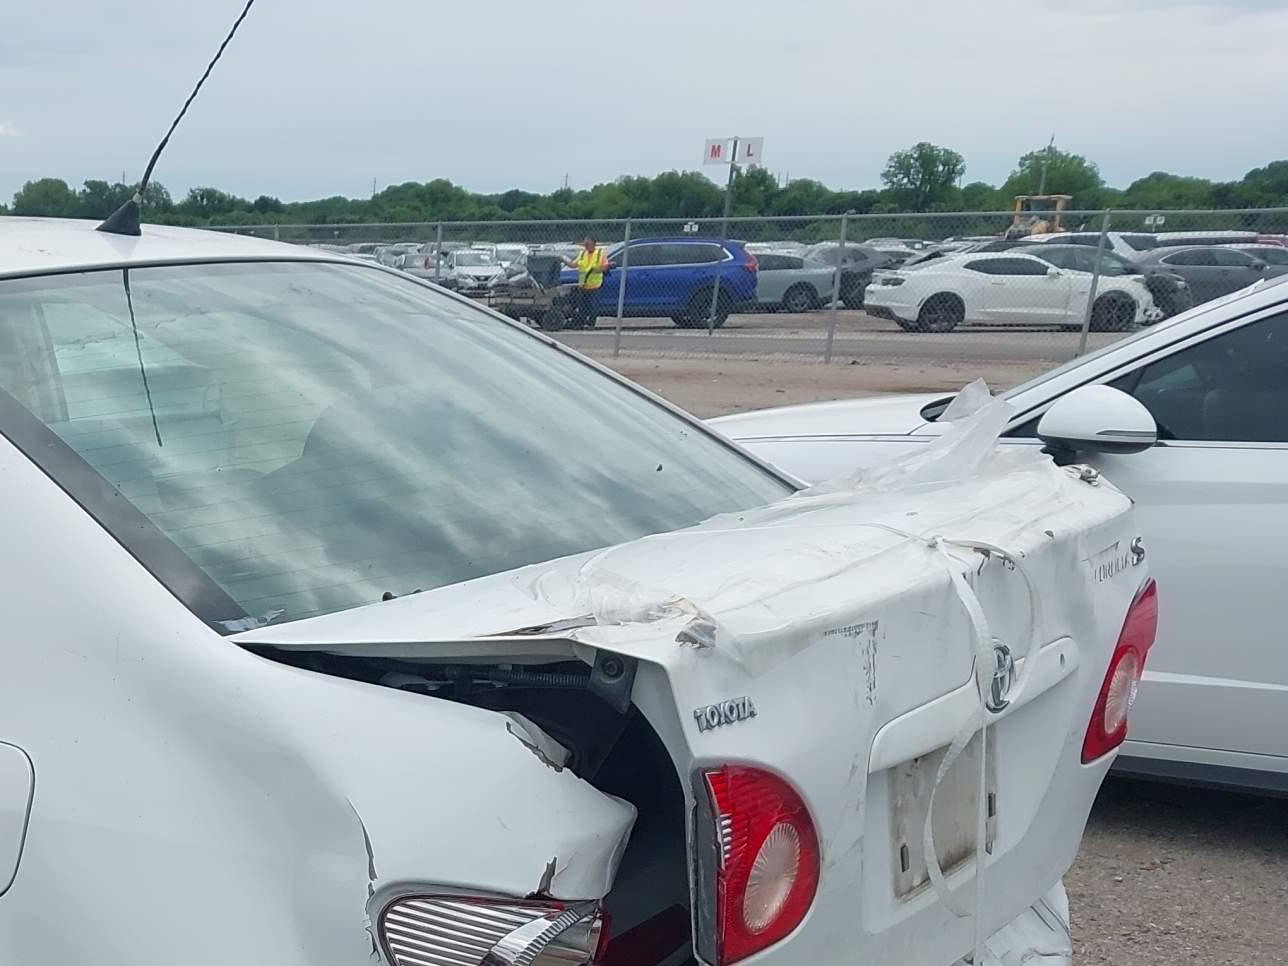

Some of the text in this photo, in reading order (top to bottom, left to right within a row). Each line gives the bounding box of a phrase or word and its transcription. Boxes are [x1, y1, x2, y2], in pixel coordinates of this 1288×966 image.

[711, 144, 721, 158] M
[747, 143, 755, 157] L
[1131, 536, 1145, 567] S
[693, 696, 757, 733] TOYOTA
